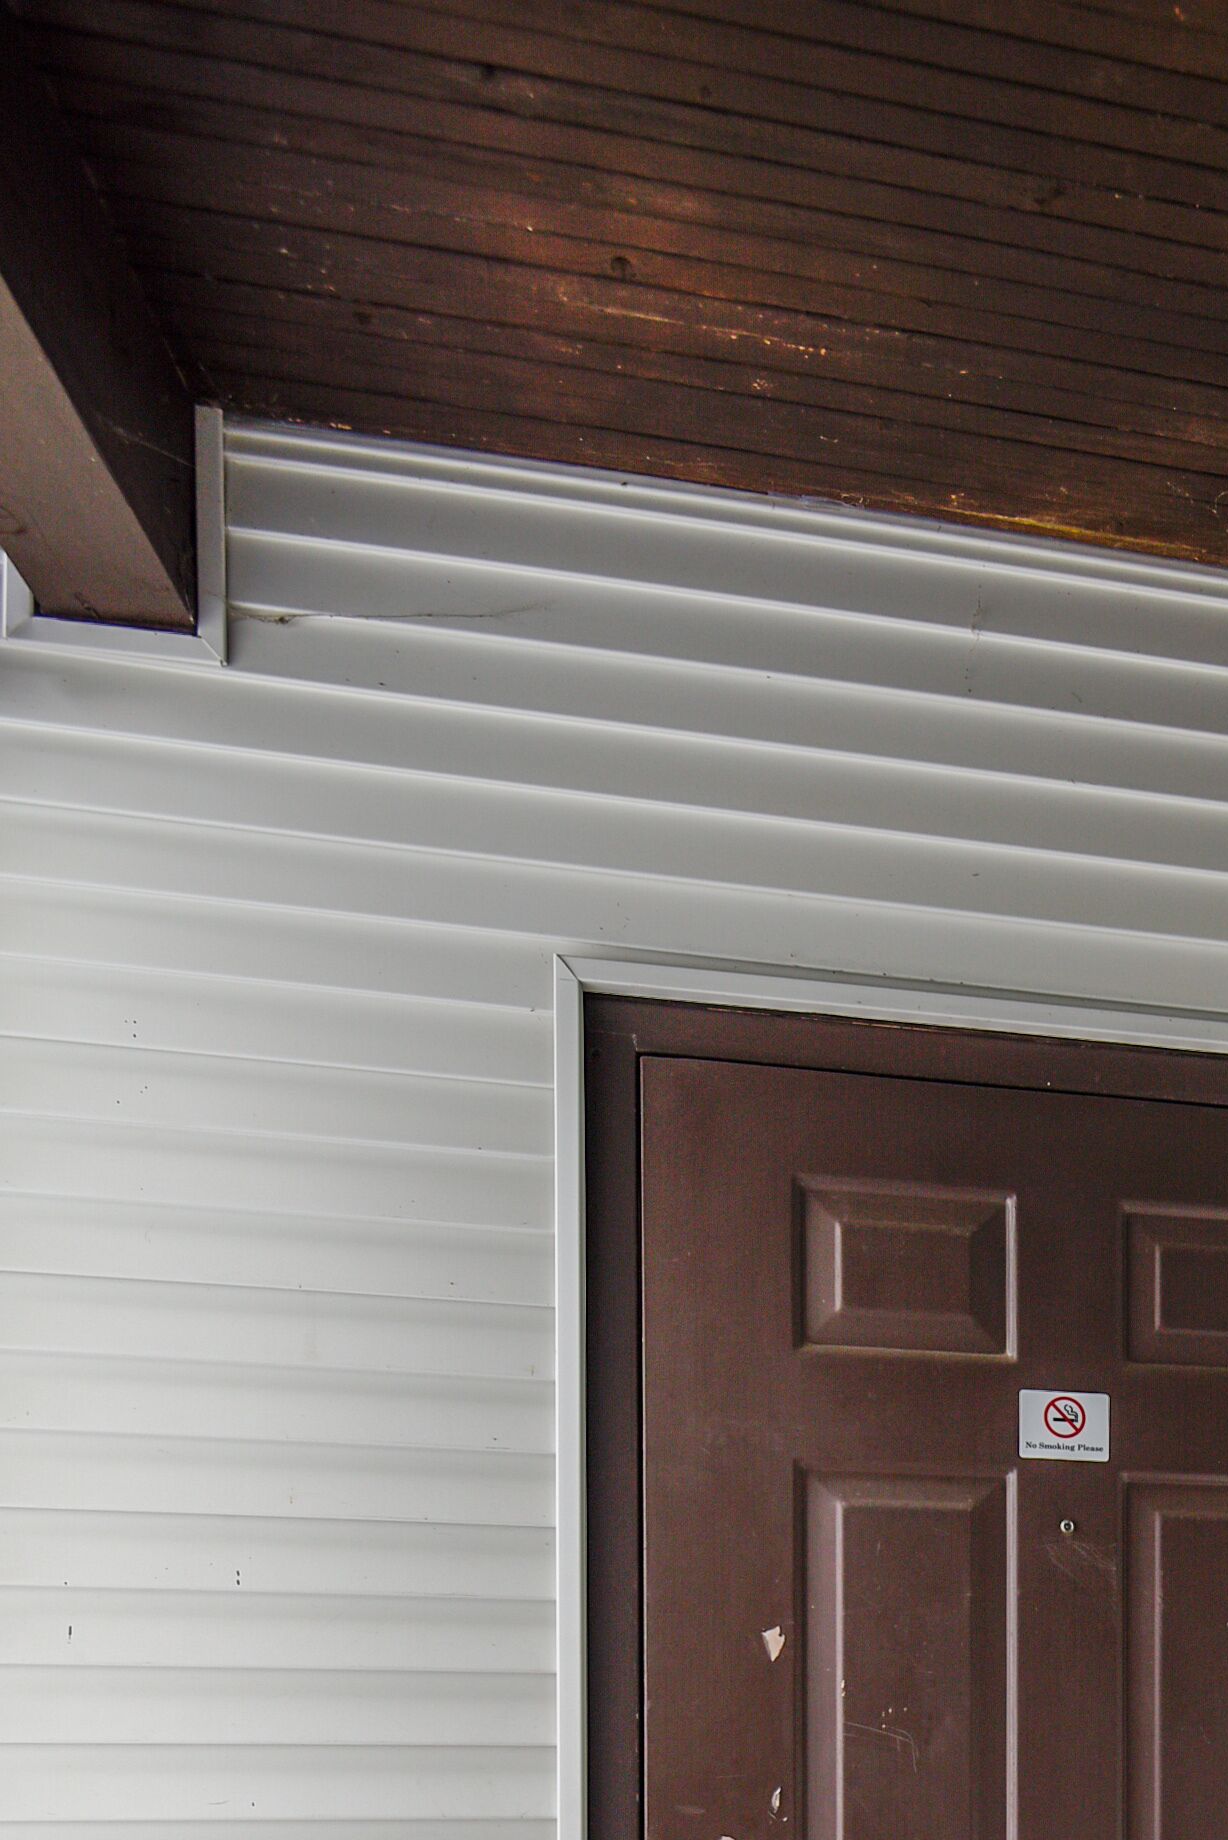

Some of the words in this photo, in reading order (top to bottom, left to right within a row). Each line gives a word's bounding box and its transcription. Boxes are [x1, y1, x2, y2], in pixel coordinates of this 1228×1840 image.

[1025, 1441, 1037, 1449] No
[1039, 1441, 1075, 1452] Smoking
[1077, 1443, 1104, 1452] Please
